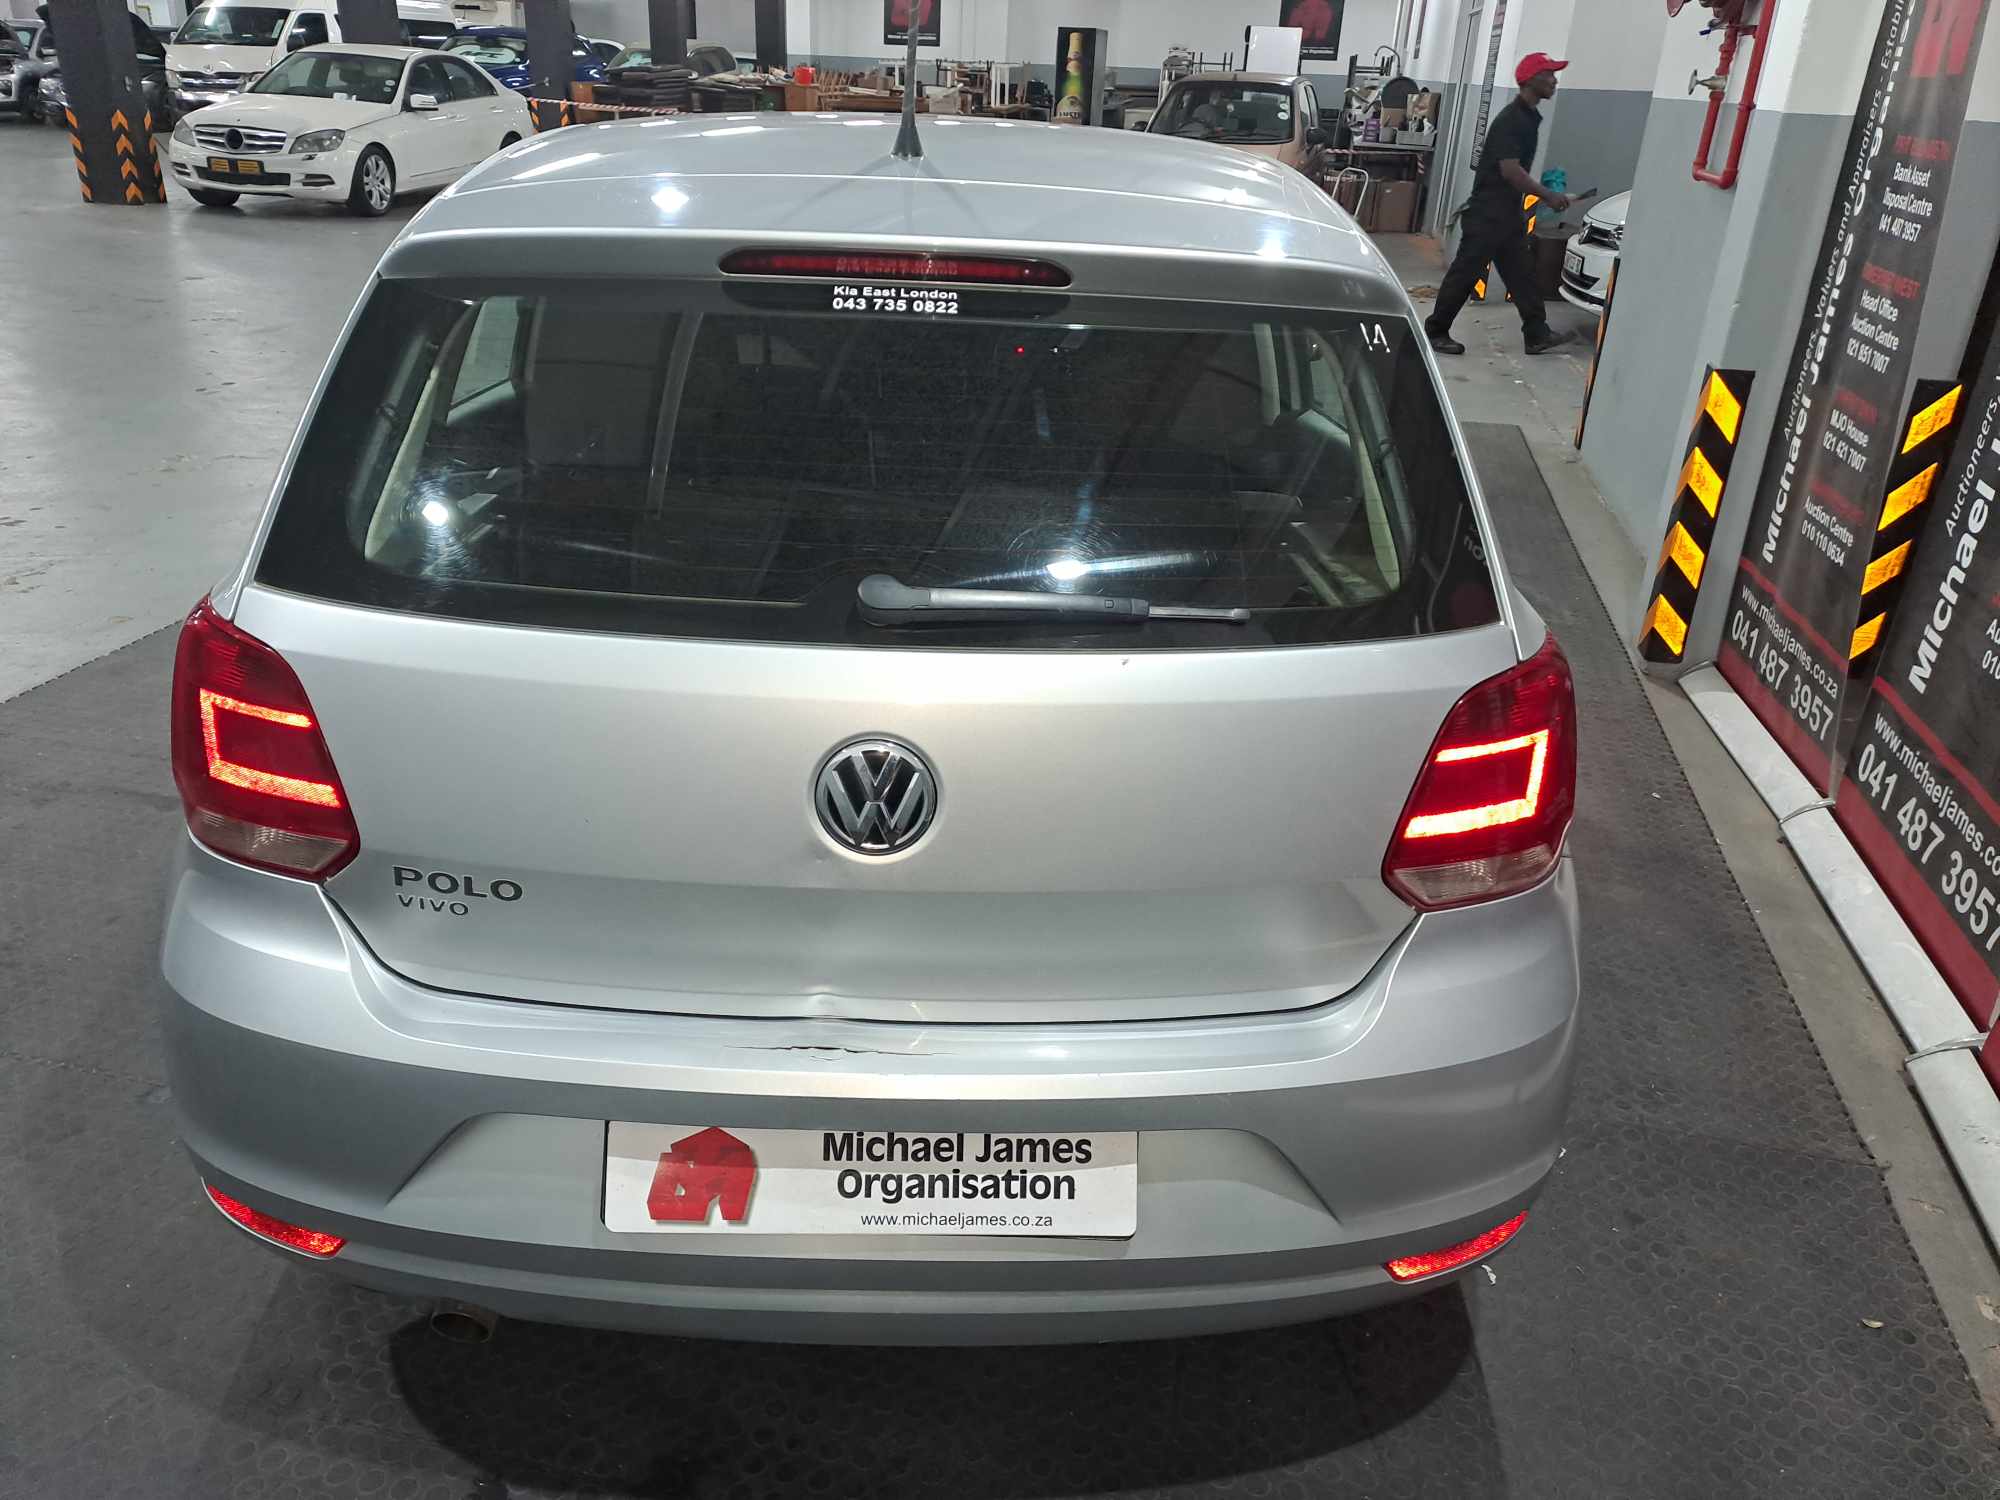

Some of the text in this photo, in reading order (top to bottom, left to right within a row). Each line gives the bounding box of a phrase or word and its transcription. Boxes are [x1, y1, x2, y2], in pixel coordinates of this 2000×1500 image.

[1893, 162, 1912, 183] Bank
[1814, 247, 1840, 318] Valuers
[1837, 201, 1851, 243] and
[1848, 89, 1882, 199] Appraisers
[1907, 193, 1933, 217] Centre
[832, 298, 958, 314] 043 735 0822
[862, 286, 896, 297] East
[900, 288, 958, 300] London
[1860, 289, 1881, 313] Head
[1874, 324, 1899, 350] Centre
[1762, 395, 1811, 564] Michael
[1811, 232, 1854, 385] James
[1846, 418, 1869, 447] House
[1801, 520, 1816, 541] 010
[1803, 496, 1830, 528] Auction
[1829, 516, 1854, 548] Centre
[1908, 478, 1996, 695] Michael
[1741, 584, 1838, 699] www.michaeljames.co.za
[1732, 609, 1834, 741] 041 487 3957
[1858, 743, 1898, 811] 041
[1897, 796, 1945, 865] 487
[392, 865, 524, 902] POLO
[396, 893, 469, 916] VIVO
[822, 1132, 1093, 1164] Michael James
[836, 1168, 1076, 1203] Organisation
[860, 1212, 1054, 1230] www.michaeljames.co.za
